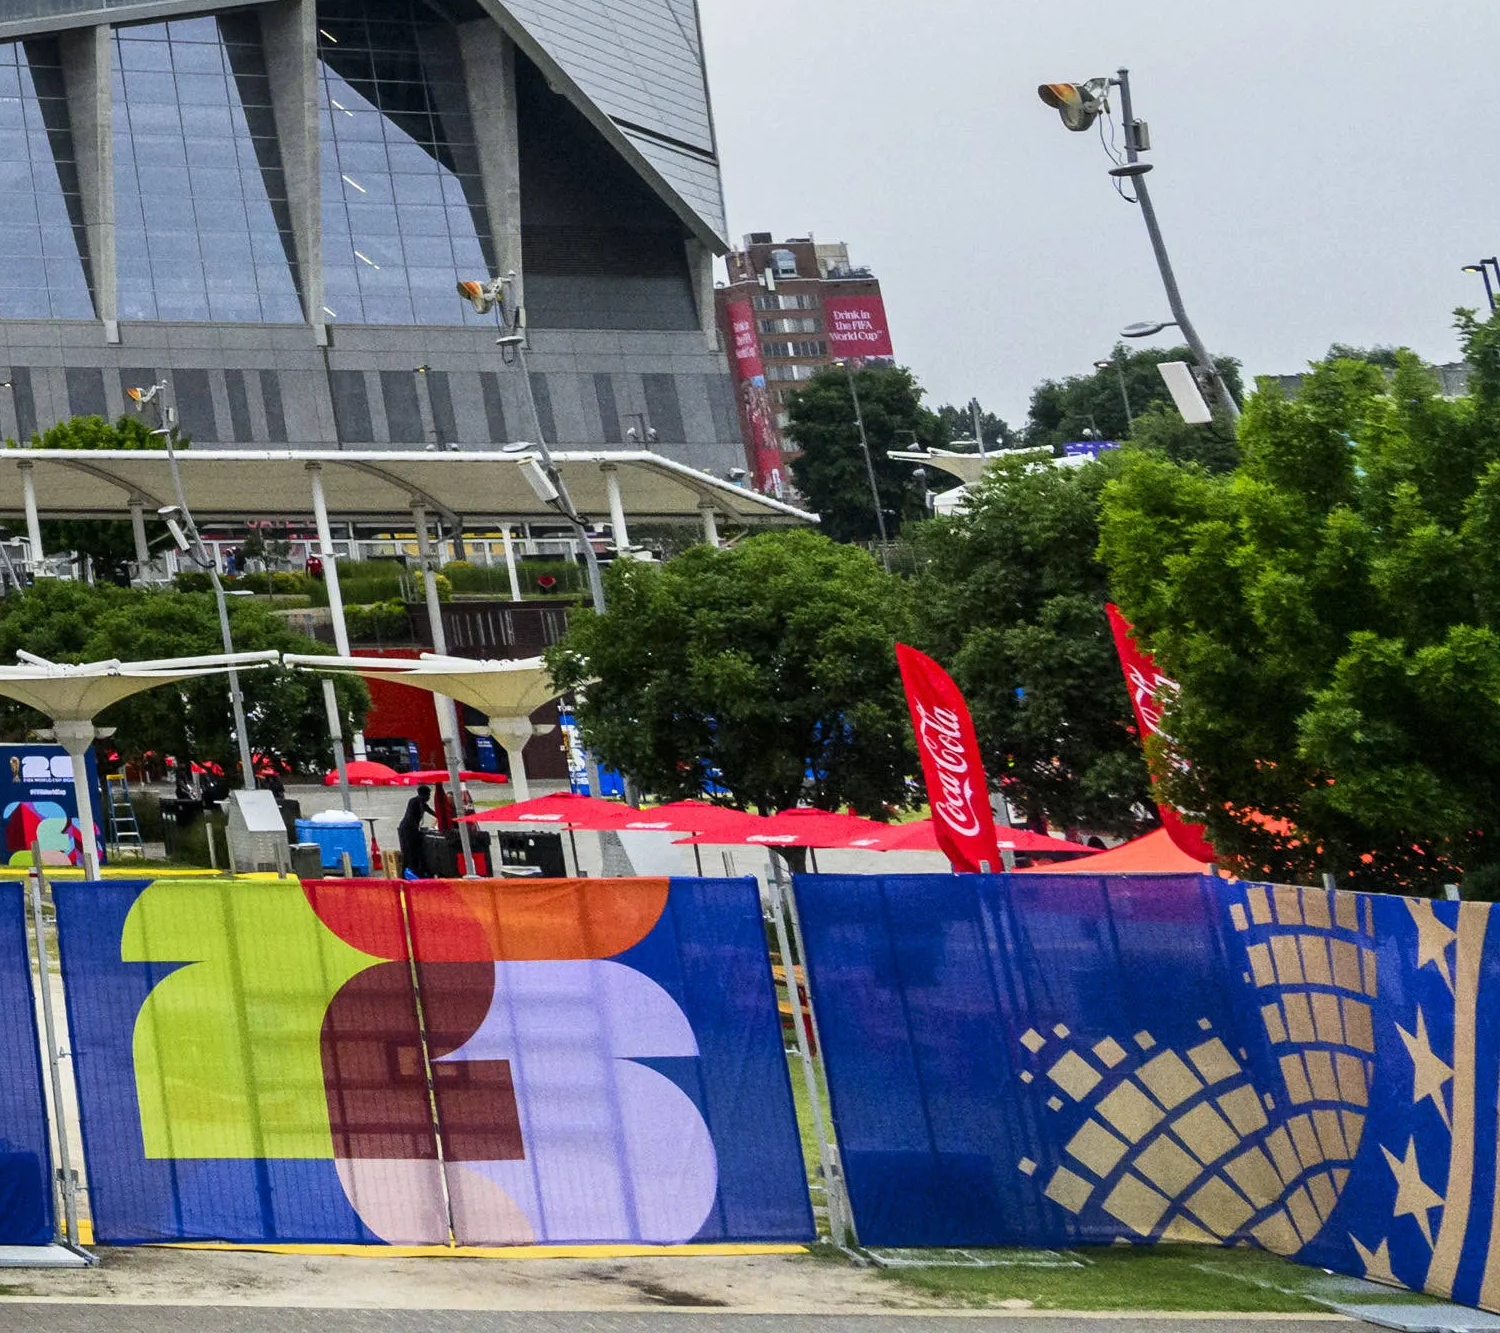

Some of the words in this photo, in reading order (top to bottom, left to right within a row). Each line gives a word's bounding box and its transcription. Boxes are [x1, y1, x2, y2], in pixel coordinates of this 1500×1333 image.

[833, 310, 859, 321] Drink
[861, 310, 871, 320] in
[835, 321, 850, 331] the
[851, 320, 873, 331] FIFA
[829, 332, 857, 341] World
[914, 697, 980, 837] Coca-Cola
